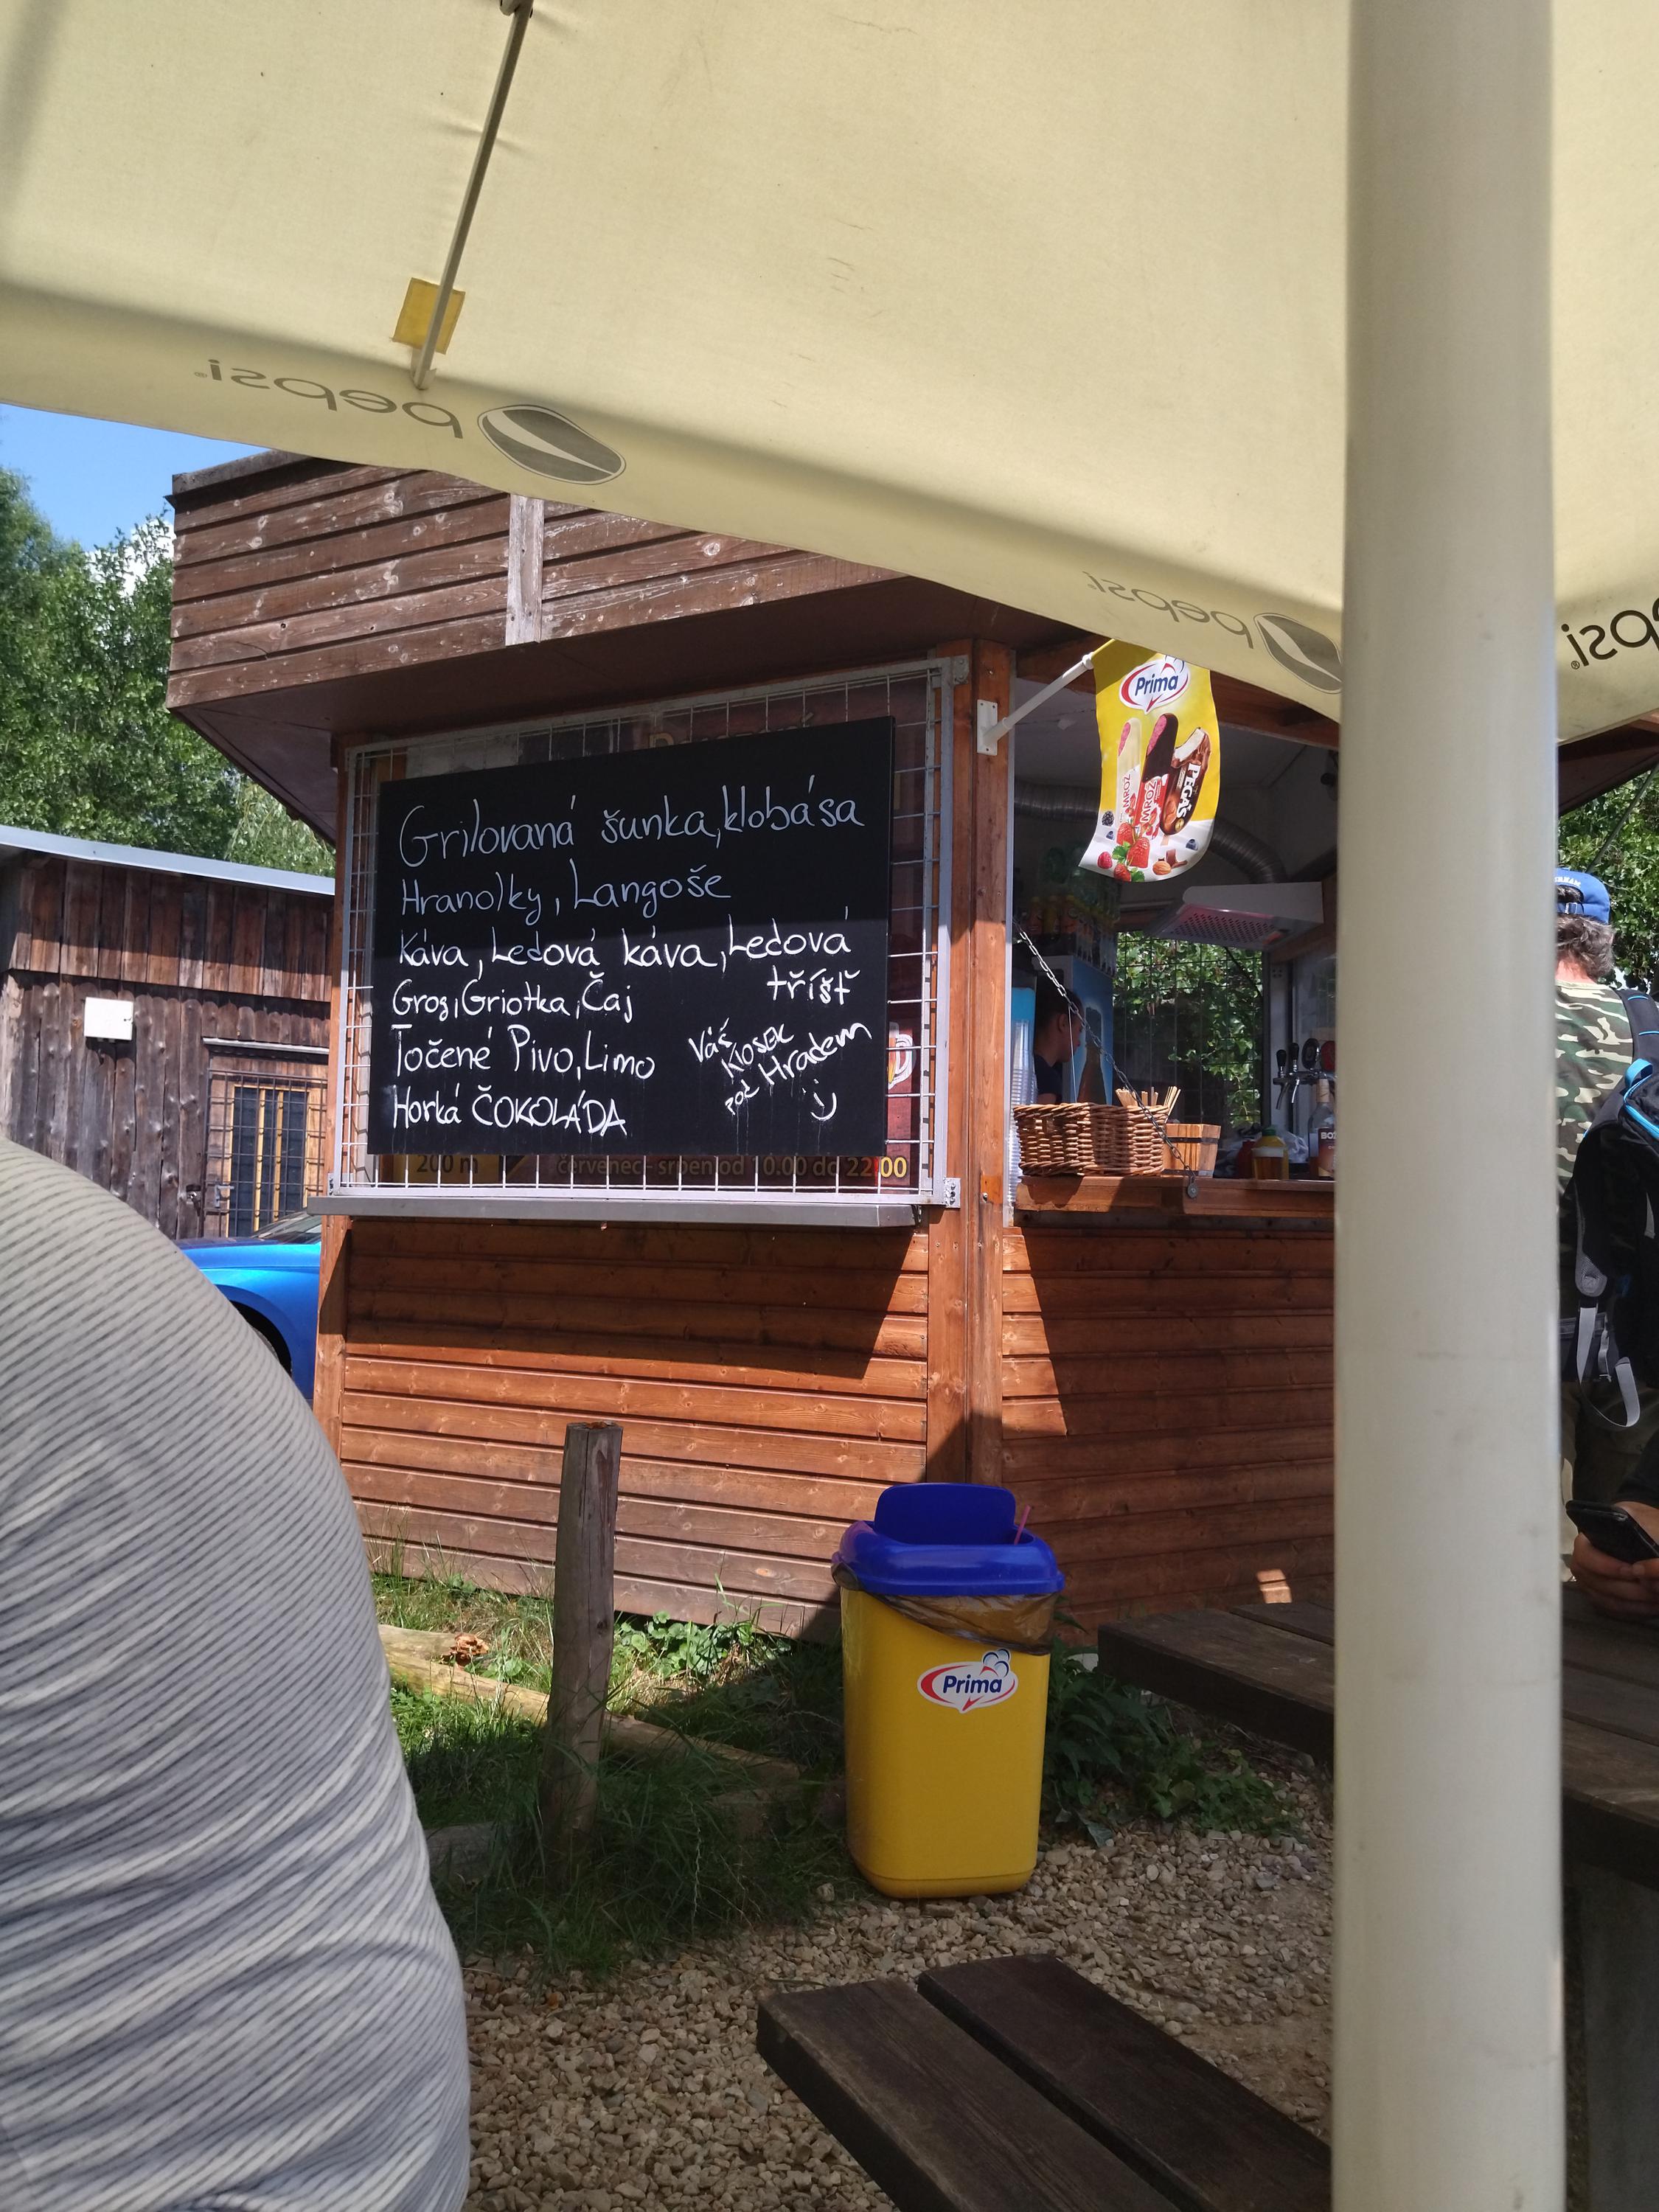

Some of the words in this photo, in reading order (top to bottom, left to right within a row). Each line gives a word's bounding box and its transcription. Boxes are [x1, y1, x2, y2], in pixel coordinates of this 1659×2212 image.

[1134, 673, 1179, 697] Prima
[399, 794, 576, 868] Grilovaná
[568, 858, 731, 919] Langoše
[390, 1023, 493, 1077] Točené
[757, 1022, 873, 1086] Hradem
[392, 1082, 462, 1130] Horká
[471, 1084, 627, 1137] ČOKOLÁDA
[416, 1155, 453, 1174] 200
[942, 1673, 1003, 1694] Prima
